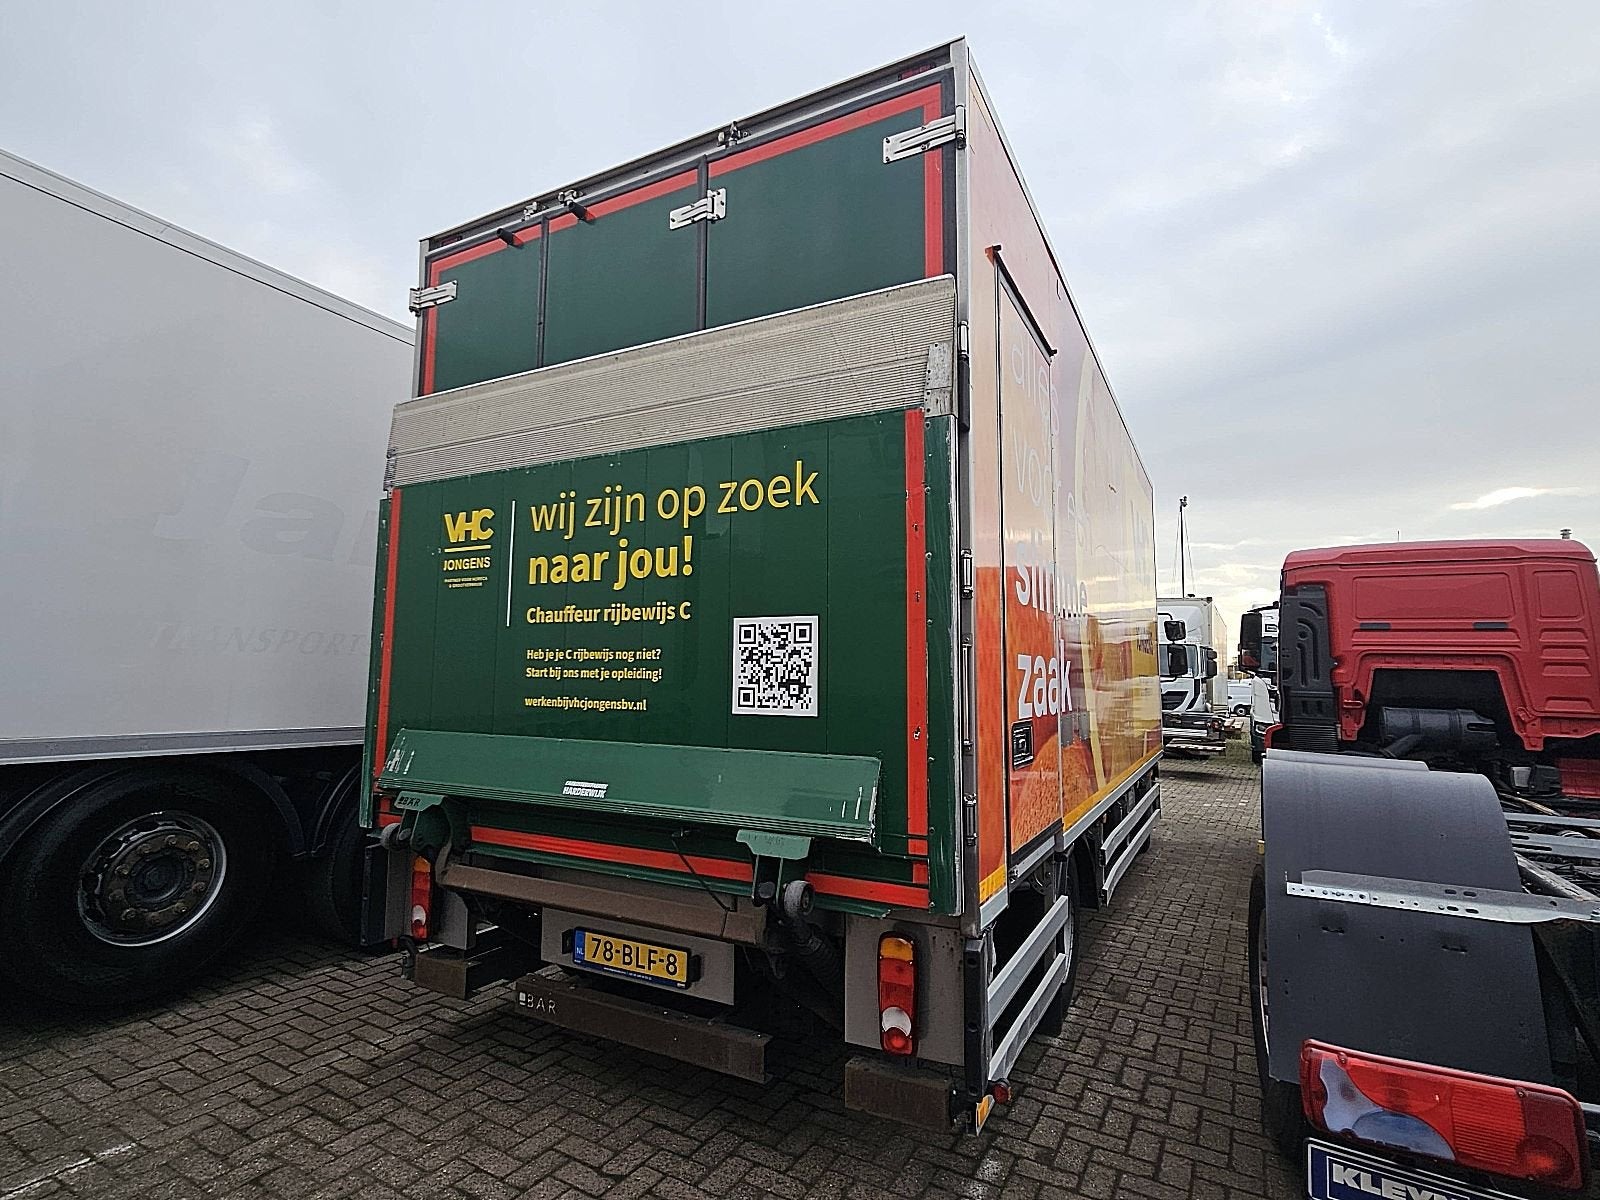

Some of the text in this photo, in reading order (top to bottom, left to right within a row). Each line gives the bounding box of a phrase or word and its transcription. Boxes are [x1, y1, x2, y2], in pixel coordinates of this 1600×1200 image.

[530, 459, 821, 540] wij zijn op zoek
[443, 508, 496, 543] VHC
[442, 556, 492, 572] JONGENS
[528, 535, 694, 591] naar jou!
[525, 601, 692, 626] Chauffeur rijbewijs C
[526, 648, 662, 663] Heb je je C rijbewijs nog niet?
[525, 667, 663, 683] Start bij ons met je opleiding!
[1017, 638, 1073, 720] zaak
[524, 696, 647, 711] werkenbijvhcjongensbv.nl
[576, 947, 585, 956] NL
[591, 936, 679, 976] 78-BLF-8
[1332, 1162, 1449, 1200] KLEY
